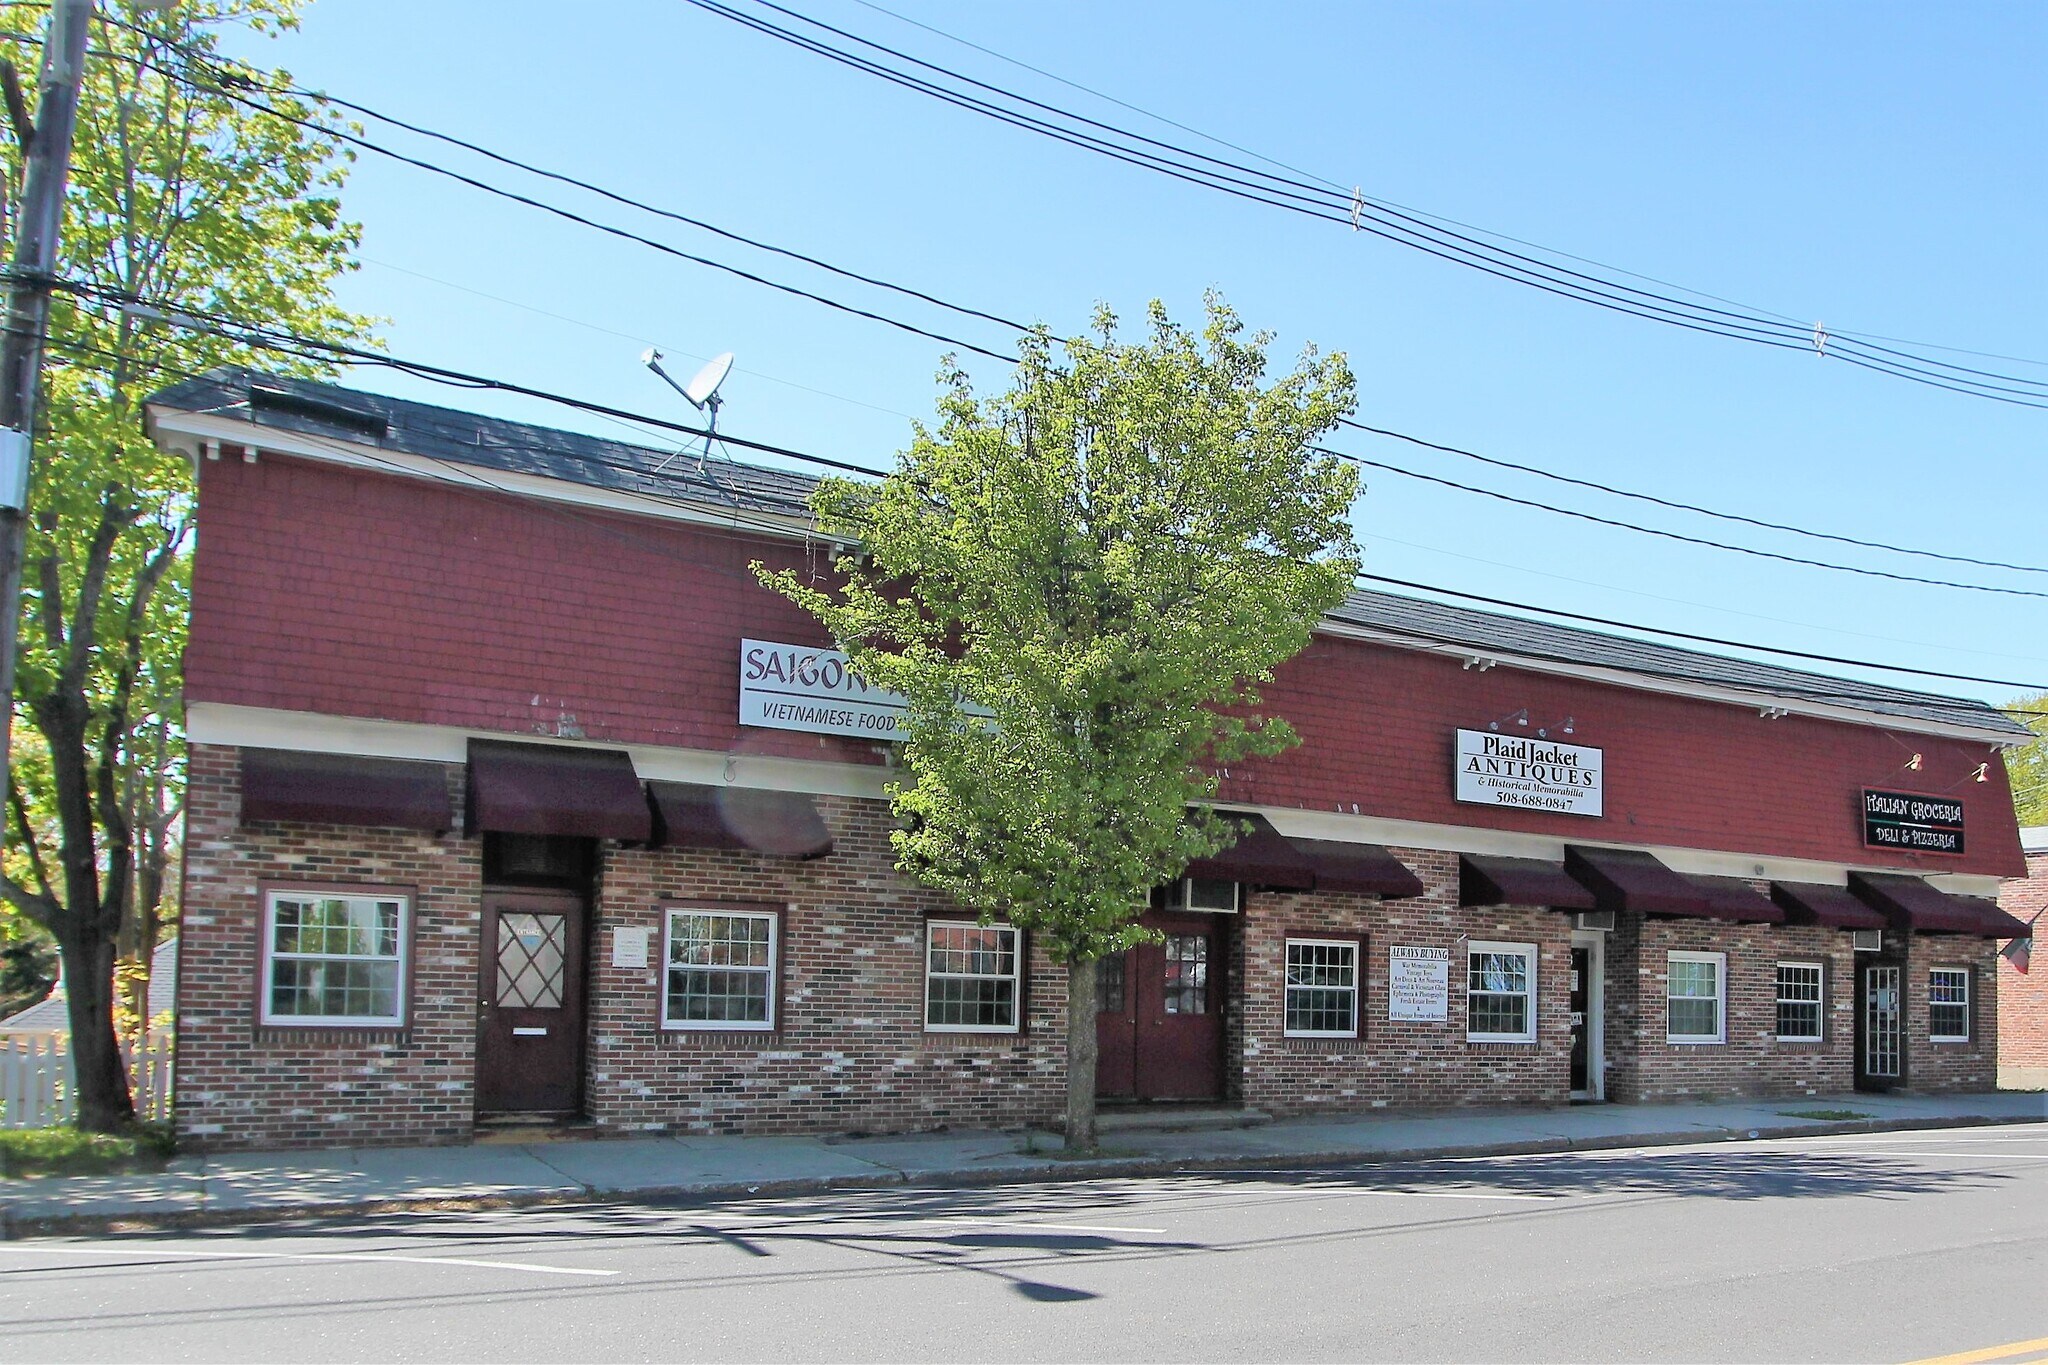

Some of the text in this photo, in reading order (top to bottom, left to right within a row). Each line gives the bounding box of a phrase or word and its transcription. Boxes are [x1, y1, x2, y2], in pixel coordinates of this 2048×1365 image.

[763, 701, 896, 732] VIETNAMESE FOOD
[1483, 736, 1578, 768] Plaid Jacket
[1467, 756, 1593, 786] ANTIQUES
[1478, 776, 1584, 798] & Historical Memorabilia
[1495, 791, 1573, 811] 508-688-0847
[1866, 794, 1962, 823] ITALIAN GROCERIA
[1876, 827, 1956, 849] DELI & PIZZERIA
[1391, 947, 1448, 960] ALWAYS BUYING
